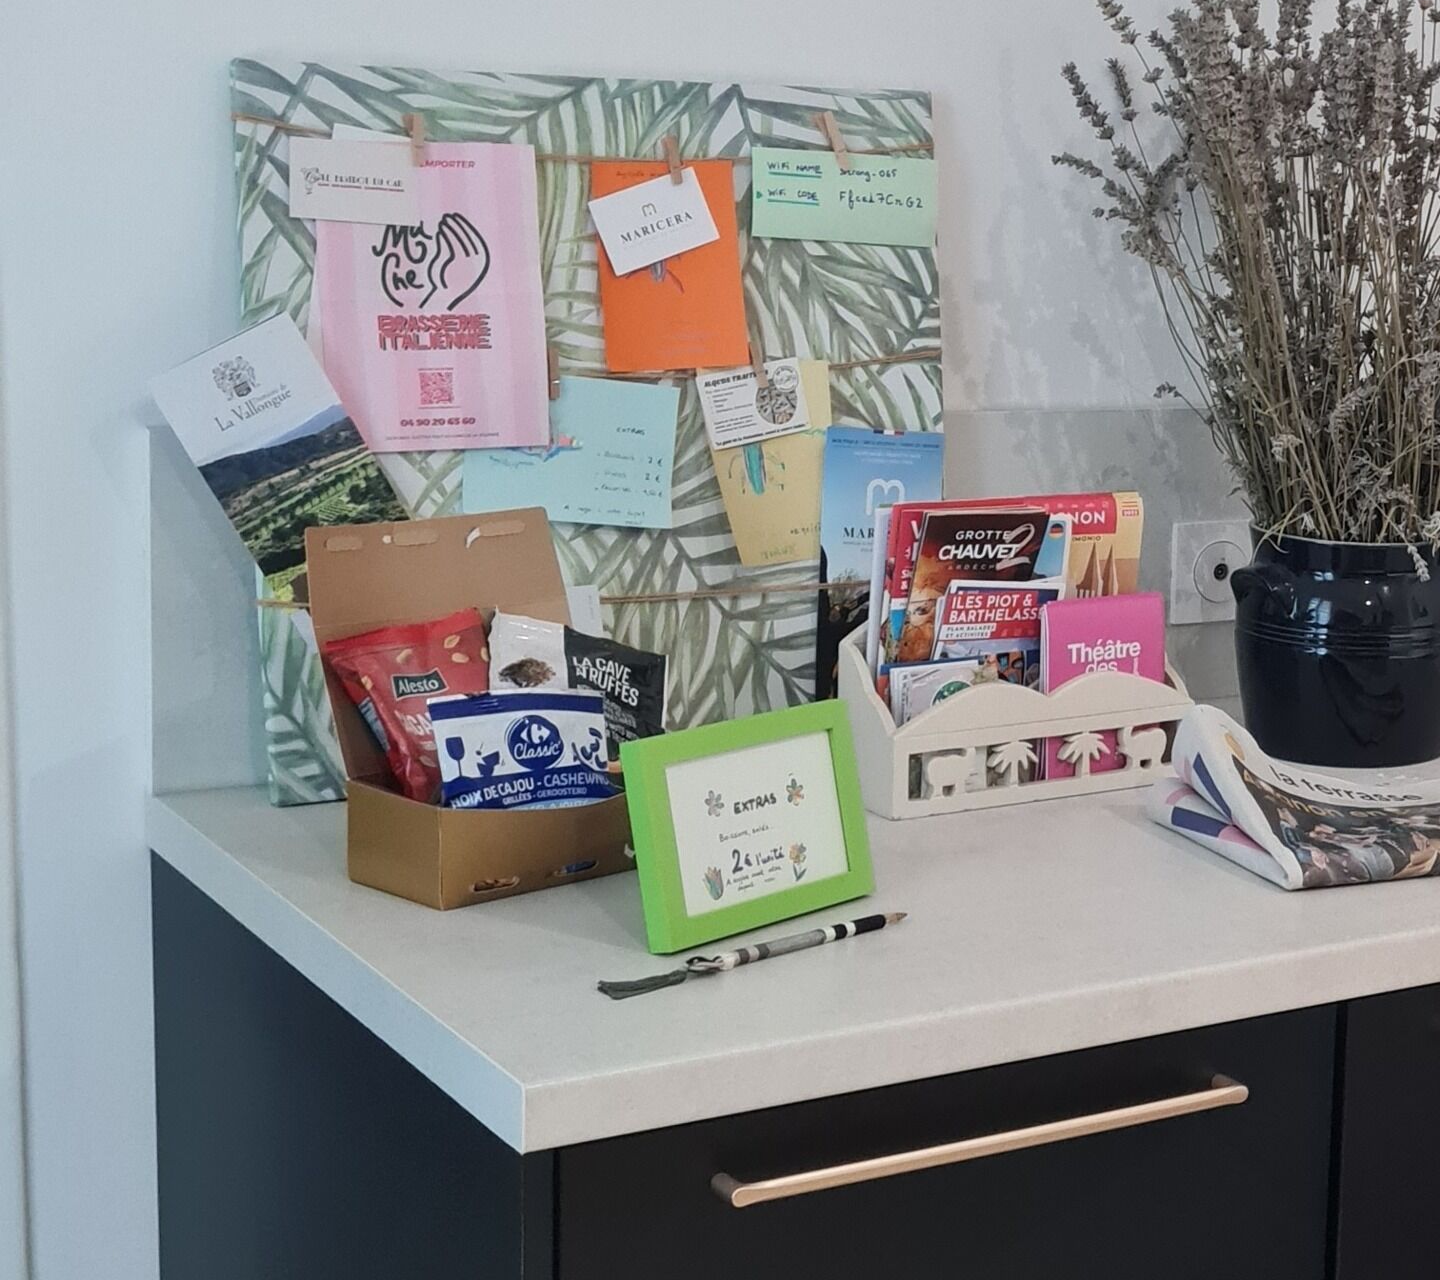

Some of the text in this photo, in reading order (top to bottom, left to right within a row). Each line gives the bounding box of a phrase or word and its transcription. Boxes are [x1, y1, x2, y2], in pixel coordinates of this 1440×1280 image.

[620, 211, 693, 245] MARICERA
[377, 314, 491, 333] BRASSERIE
[378, 331, 492, 350] ITALIENNE
[231, 389, 292, 421] Vallongue
[956, 530, 1012, 541] GROTTE
[938, 544, 1020, 561] CHAUVET
[986, 595, 1019, 608] PIOT
[1023, 593, 1033, 608] &
[1067, 638, 1141, 665] Théâtre
[573, 656, 632, 686] LA CAVE
[399, 678, 441, 694] Alesto
[580, 666, 640, 707] TRUFFES
[484, 786, 498, 800] DE
[498, 777, 535, 797] CAJOU
[1269, 764, 1424, 803] la terrasse
[733, 792, 777, 815] EXTRAS
